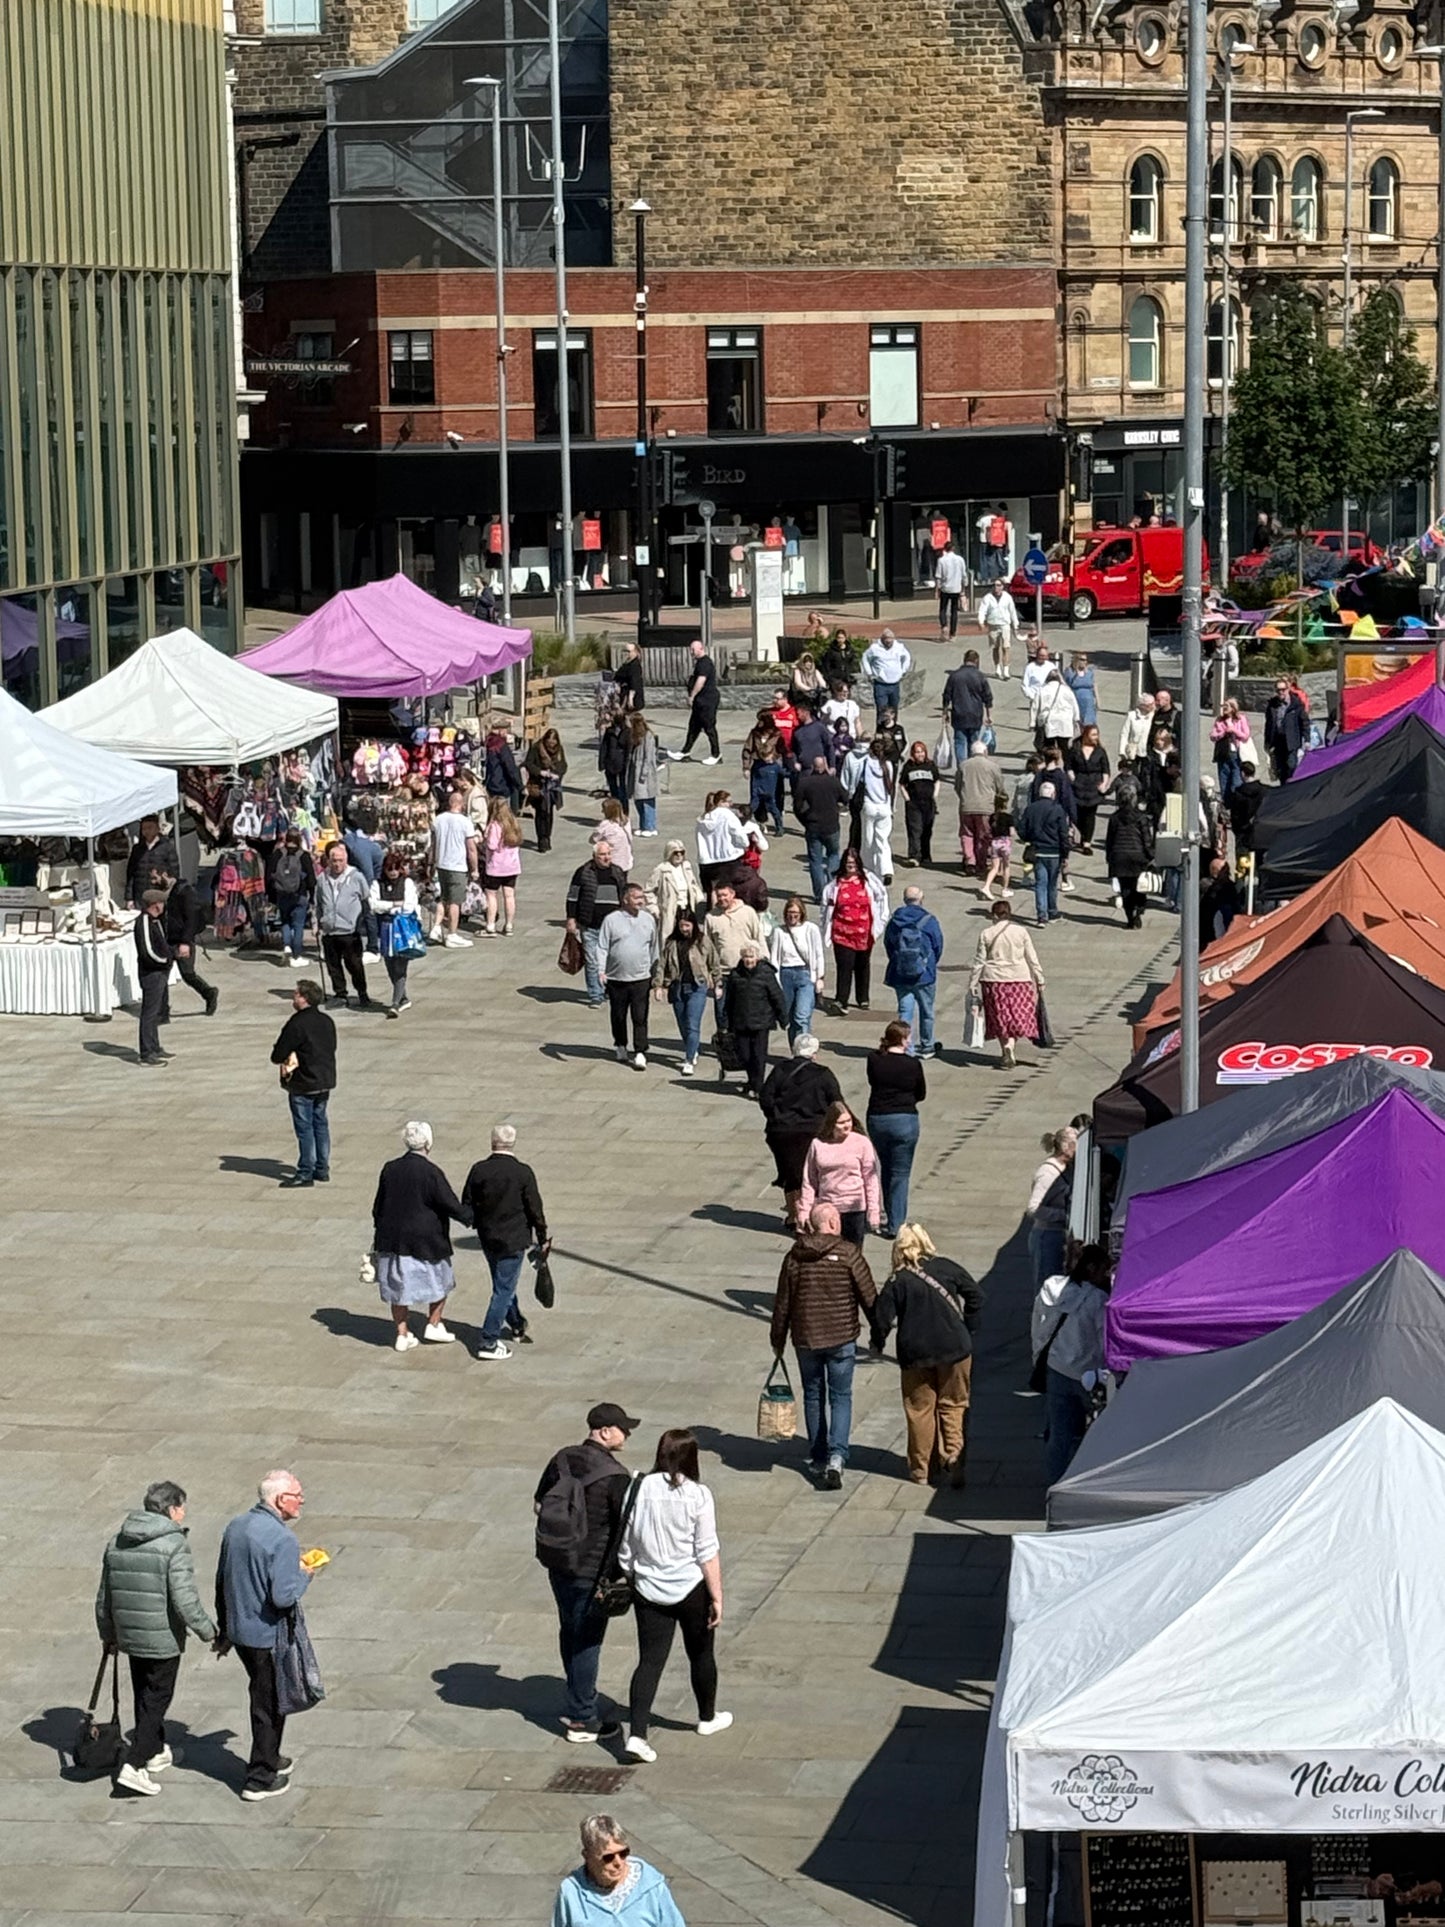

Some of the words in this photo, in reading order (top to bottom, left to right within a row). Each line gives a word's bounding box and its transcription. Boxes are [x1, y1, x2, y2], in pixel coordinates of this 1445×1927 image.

[250, 362, 268, 371] THE
[268, 363, 315, 371] VICTORIAN
[317, 364, 350, 372] ARCADE
[1051, 1779, 1088, 1795] Nidra
[1093, 1779, 1154, 1796] Collections
[1290, 1760, 1388, 1798] Nidra
[1332, 1803, 1391, 1825] Sterling
[1394, 1803, 1438, 1820] Silver
